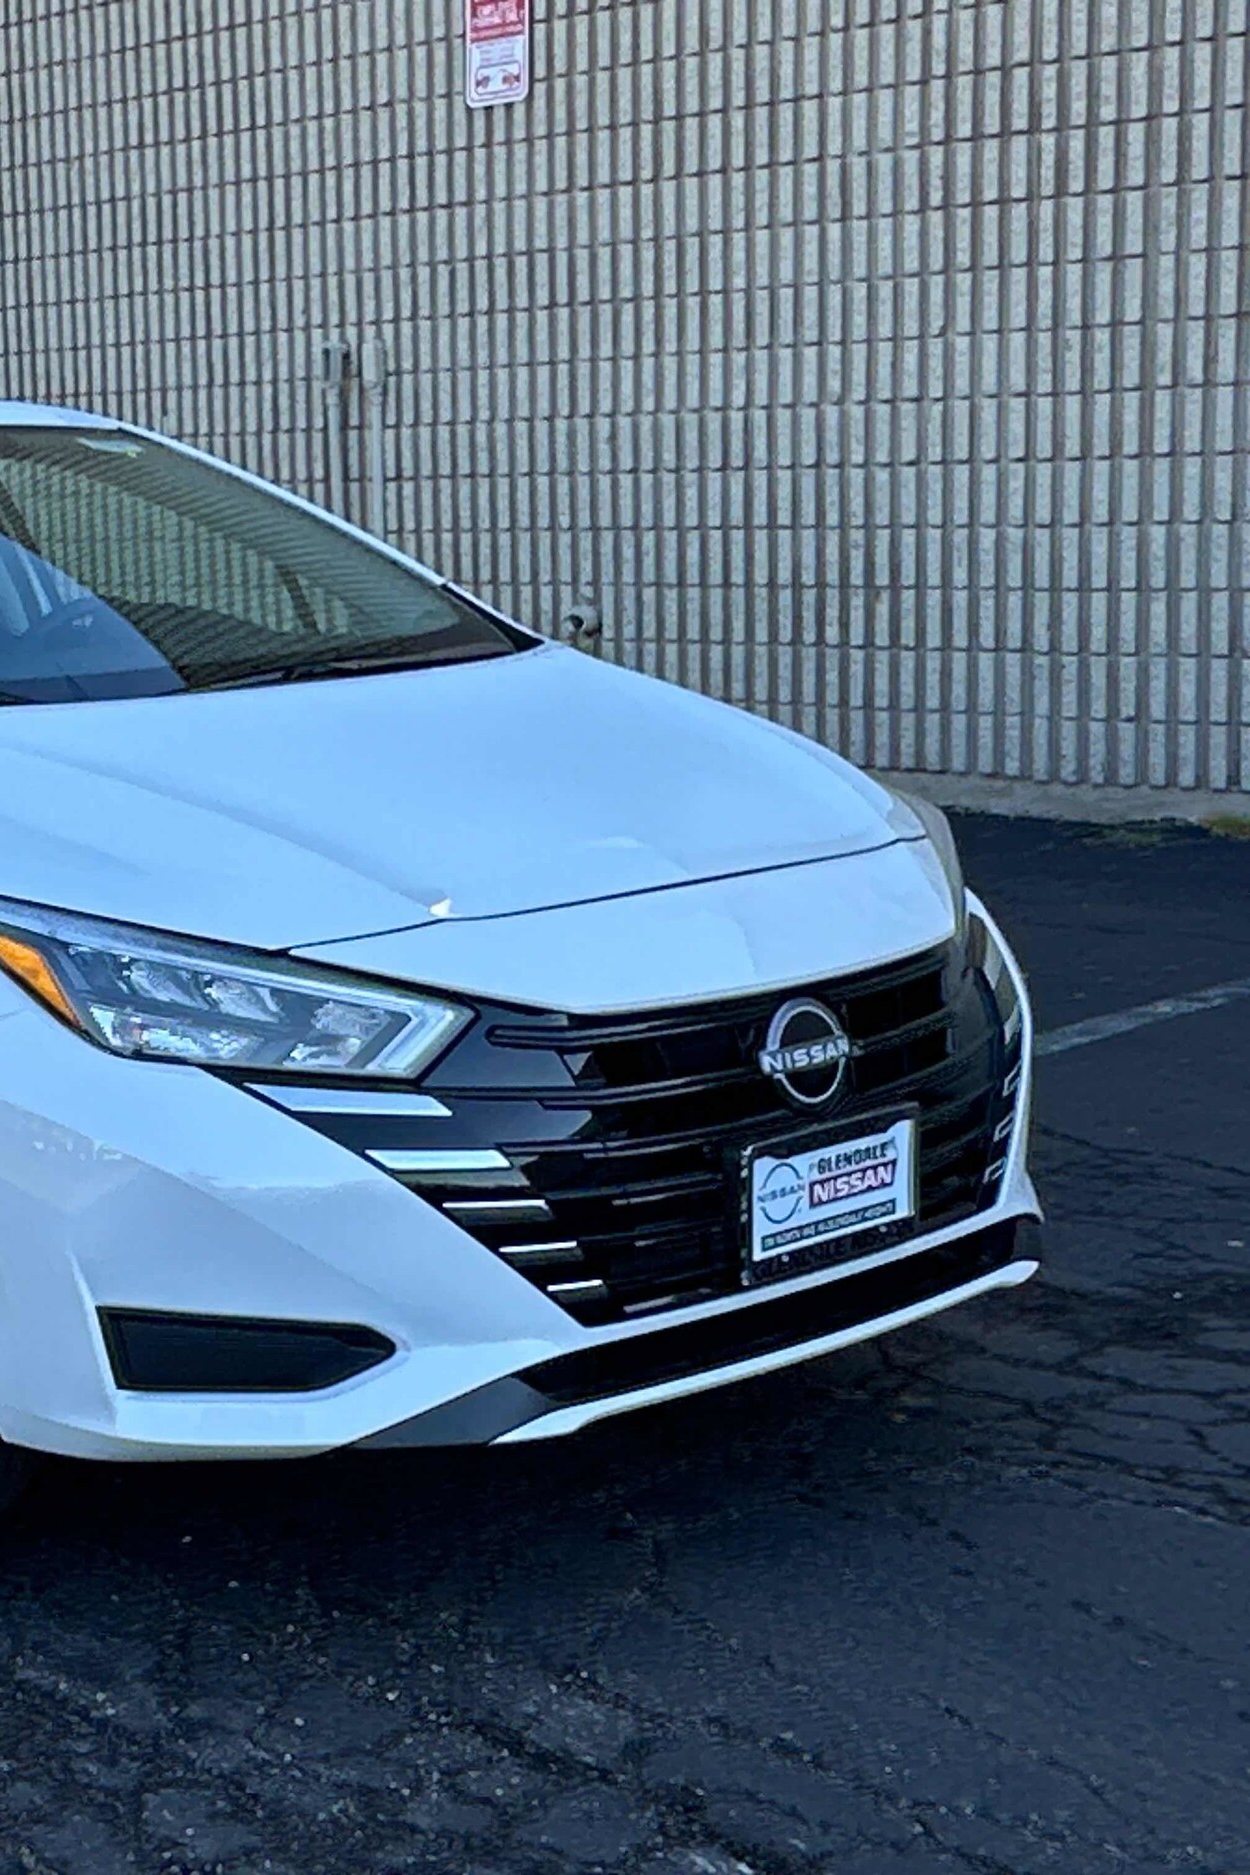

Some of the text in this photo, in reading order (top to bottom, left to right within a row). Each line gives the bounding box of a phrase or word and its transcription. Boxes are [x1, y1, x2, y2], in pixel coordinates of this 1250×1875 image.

[761, 1035, 849, 1074] NISSAN
[816, 1141, 888, 1175] GLENDALE
[757, 1182, 805, 1204] NISSAN
[812, 1164, 894, 1204] NISSAN
